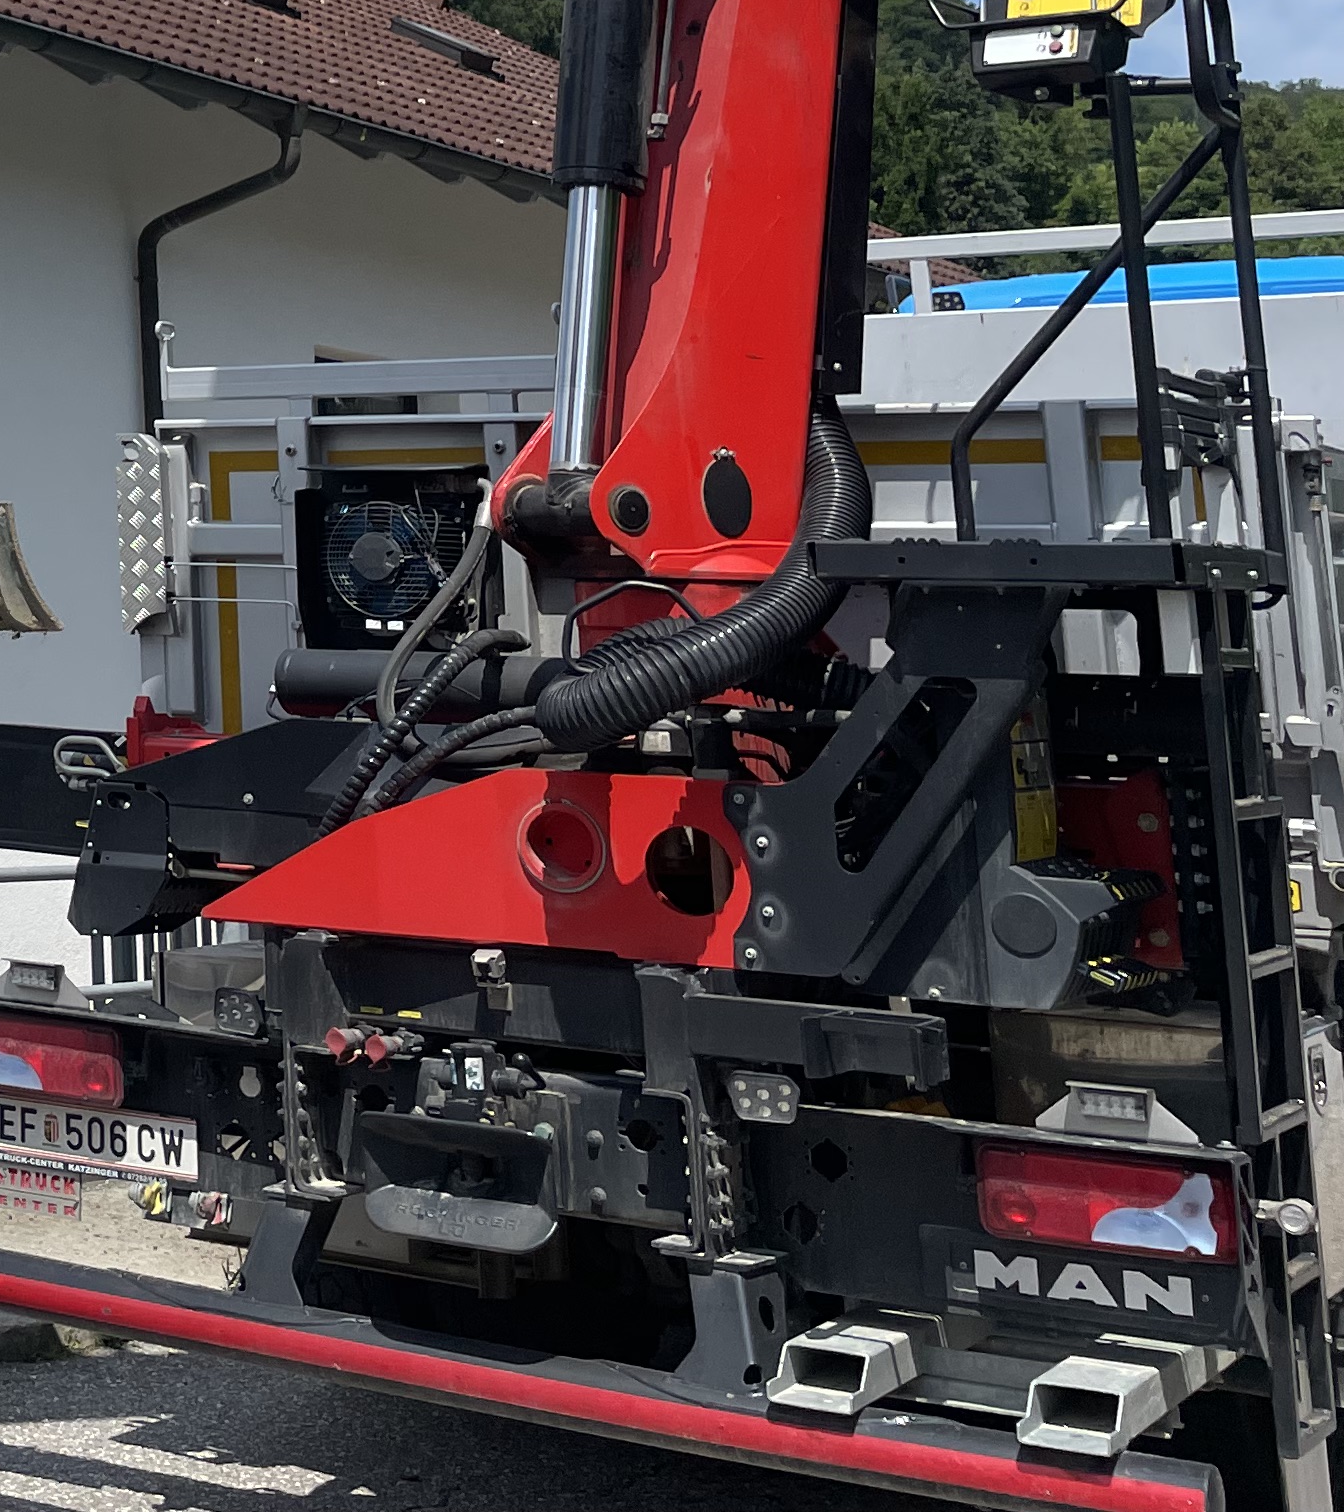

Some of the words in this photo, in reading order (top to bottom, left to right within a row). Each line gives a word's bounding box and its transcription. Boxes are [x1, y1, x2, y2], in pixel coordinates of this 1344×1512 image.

[8, 1168, 76, 1196] TRUCK
[68, 1163, 119, 1179] KATZINGER
[973, 1249, 1194, 1318] MAN
